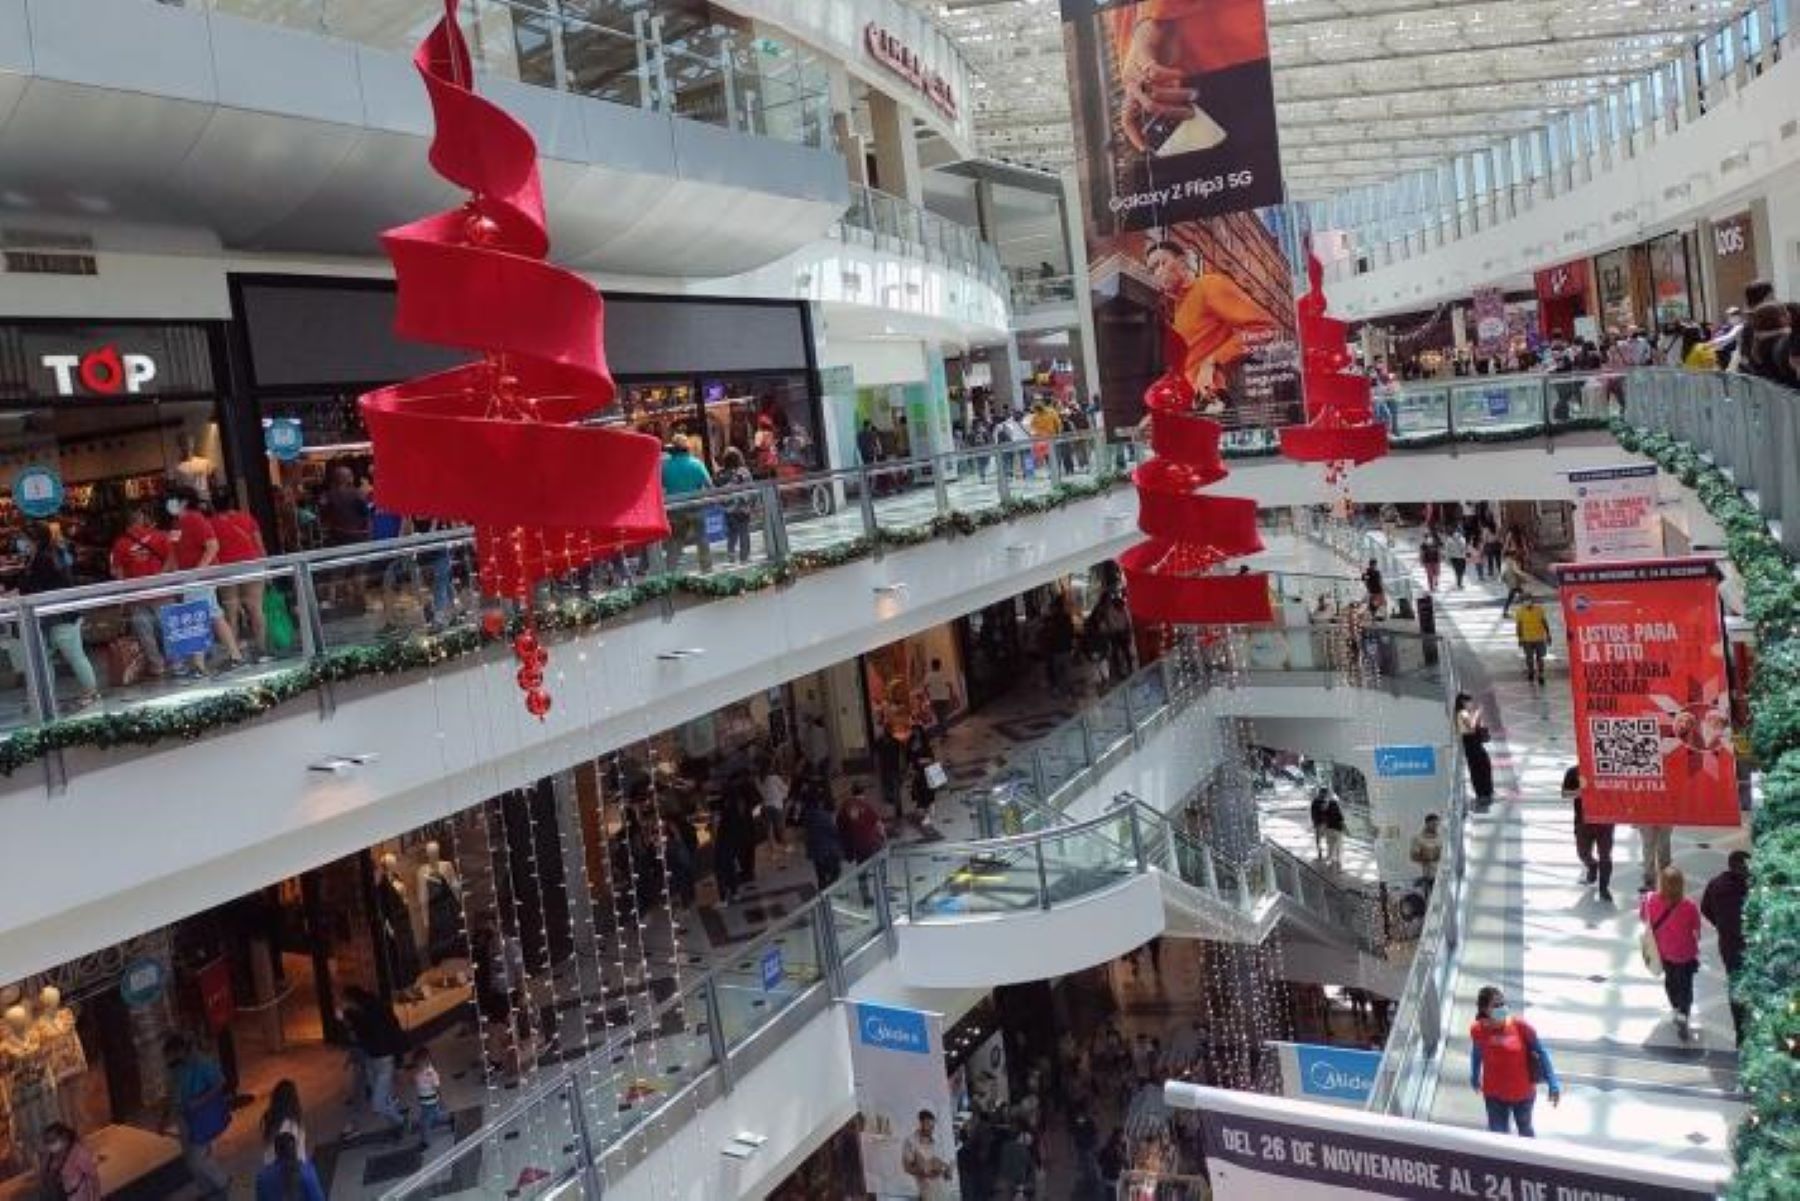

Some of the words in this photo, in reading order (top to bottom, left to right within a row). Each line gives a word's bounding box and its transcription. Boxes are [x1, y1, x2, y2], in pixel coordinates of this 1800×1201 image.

[1109, 188, 1170, 212] Galaxy
[1171, 183, 1183, 200] Z
[1184, 174, 1224, 199] Flip3
[1227, 170, 1253, 188] 5G
[41, 345, 156, 396] TOP
[1577, 624, 1628, 643] LISTOS
[1634, 622, 1679, 641] PARA
[1581, 642, 1600, 662] LA
[1605, 643, 1643, 662] FOTO
[1584, 661, 1628, 678] LISTOS
[1634, 660, 1671, 678] PARA
[1222, 1127, 1256, 1156] DEL
[1260, 1134, 1286, 1162] 26
[1290, 1138, 1318, 1168] DE
[1321, 1144, 1444, 1191] NOVIEMBRE
[1450, 1166, 1479, 1197] AL
[1484, 1173, 1514, 1201] 24
[1518, 1178, 1548, 1201] DE
